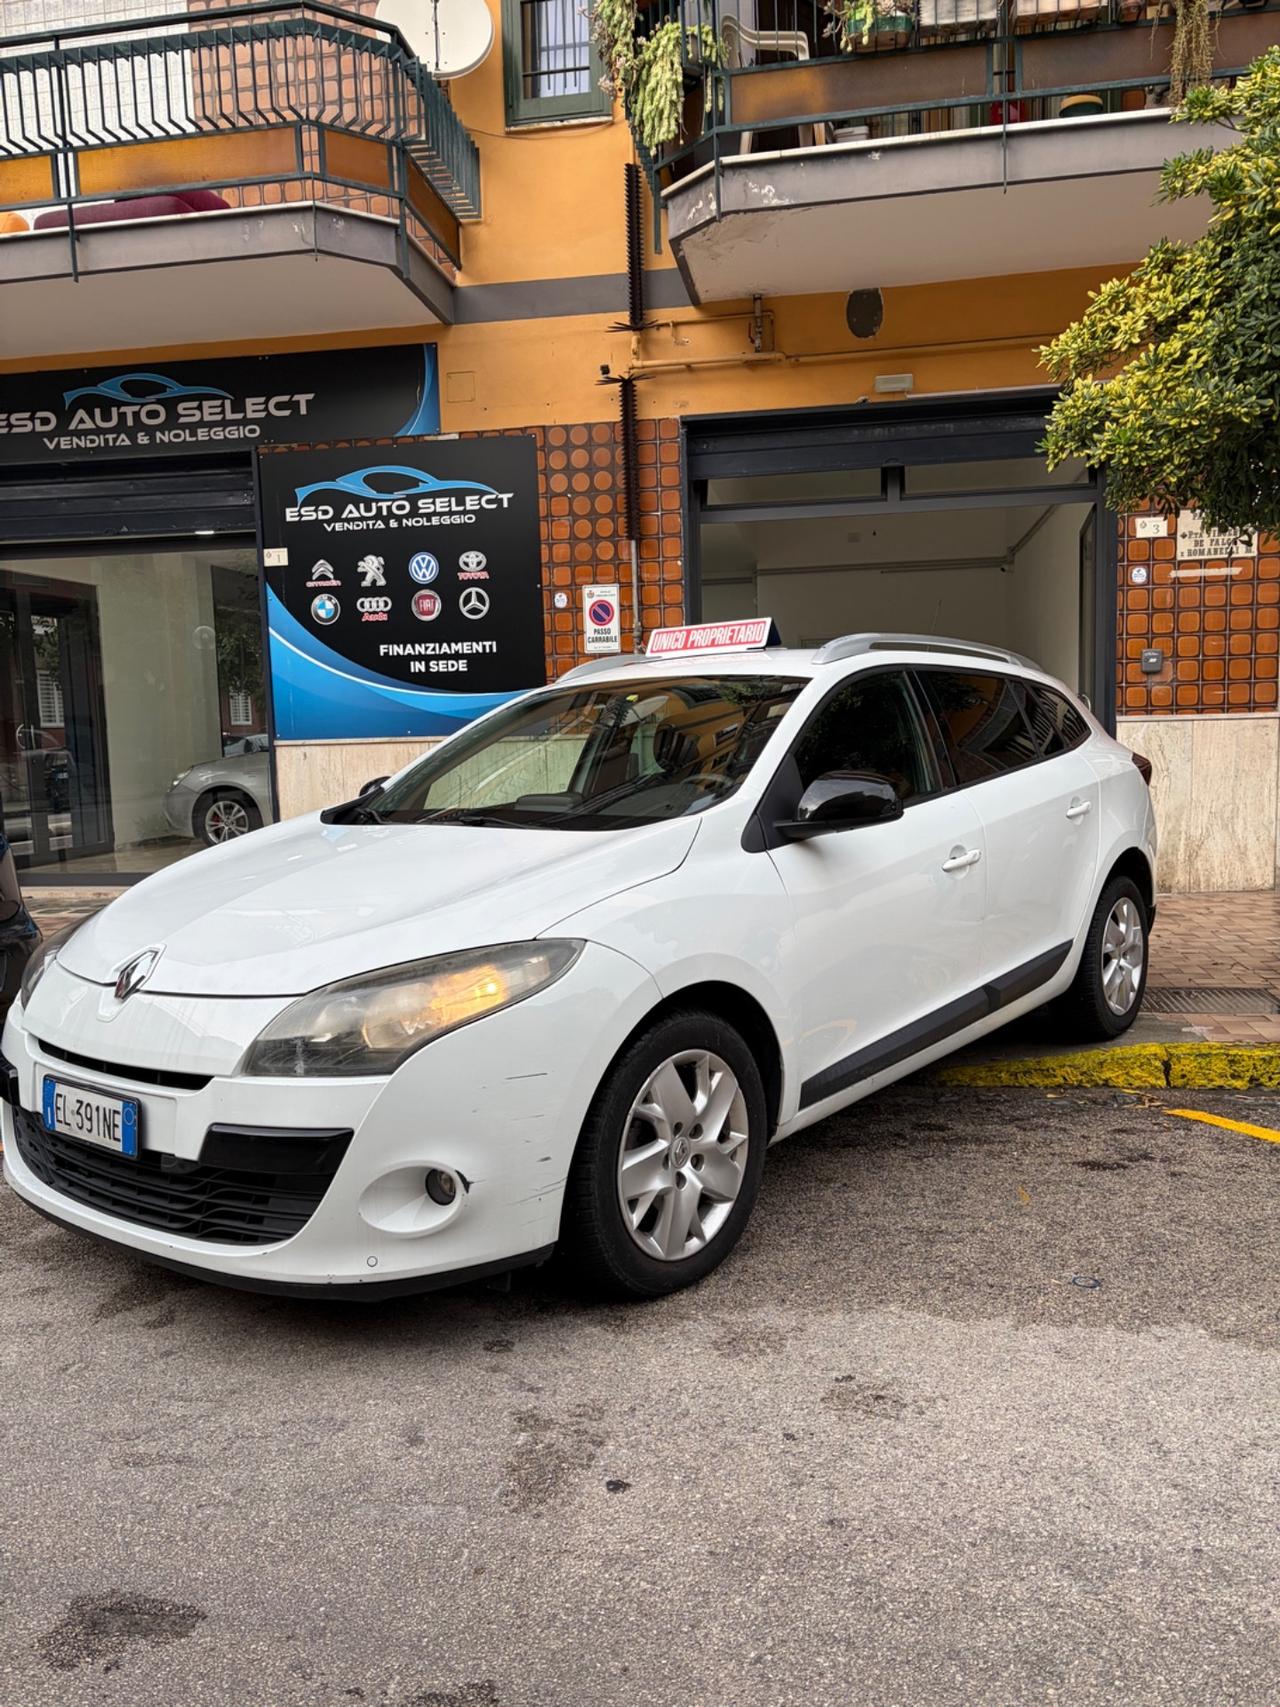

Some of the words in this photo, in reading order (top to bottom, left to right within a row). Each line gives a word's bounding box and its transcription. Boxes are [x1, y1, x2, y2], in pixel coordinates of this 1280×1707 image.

[68, 404, 167, 430] AUTO
[177, 393, 316, 424] SELECT
[42, 432, 132, 450] VENDITA
[137, 431, 150, 444] &
[155, 424, 261, 443] NOLEGGIO
[285, 505, 335, 522] ESD
[341, 500, 411, 519] AUTO
[417, 493, 515, 514] SELECT
[323, 519, 386, 532] VENDITA
[389, 518, 399, 528] &
[402, 513, 476, 527] NOLEGGIO
[1152, 523, 1160, 534] 3
[587, 635, 618, 644] CARRABILE
[593, 628, 611, 636] PASSO
[652, 630, 687, 651] UNICO
[687, 622, 765, 648] PROPRIETARIO
[379, 641, 497, 656] FINANZIAMENTI
[410, 661, 428, 673] IN
[429, 660, 468, 673] SEDE
[75, 1099, 121, 1142] 391NE
